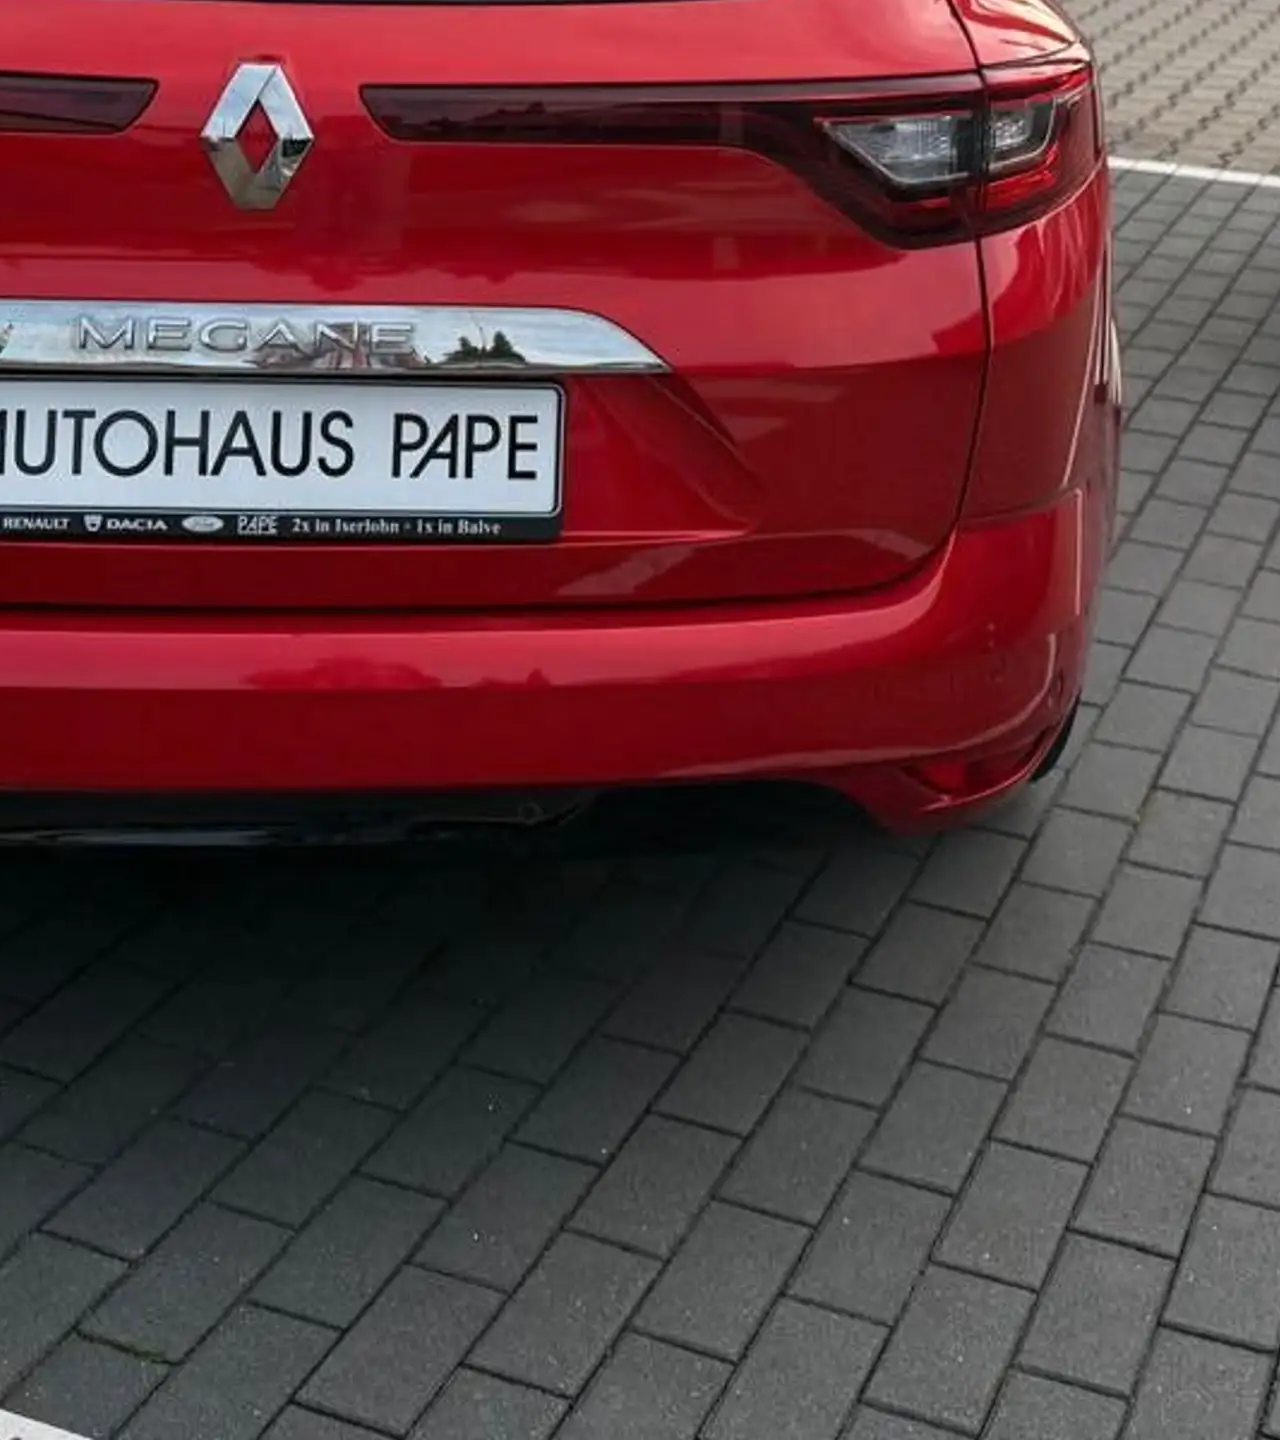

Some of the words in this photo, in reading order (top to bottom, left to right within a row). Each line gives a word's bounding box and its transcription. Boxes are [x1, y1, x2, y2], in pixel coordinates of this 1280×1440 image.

[75, 317, 417, 355] MEGANE
[389, 412, 540, 481] PAPE
[3, 516, 71, 531] RENAULT
[106, 518, 168, 532] DACIA
[237, 515, 278, 534] PAPE
[292, 517, 310, 533] 2x
[334, 517, 400, 535] Iserlohn
[438, 518, 453, 535] in
[457, 518, 503, 536] Balve
